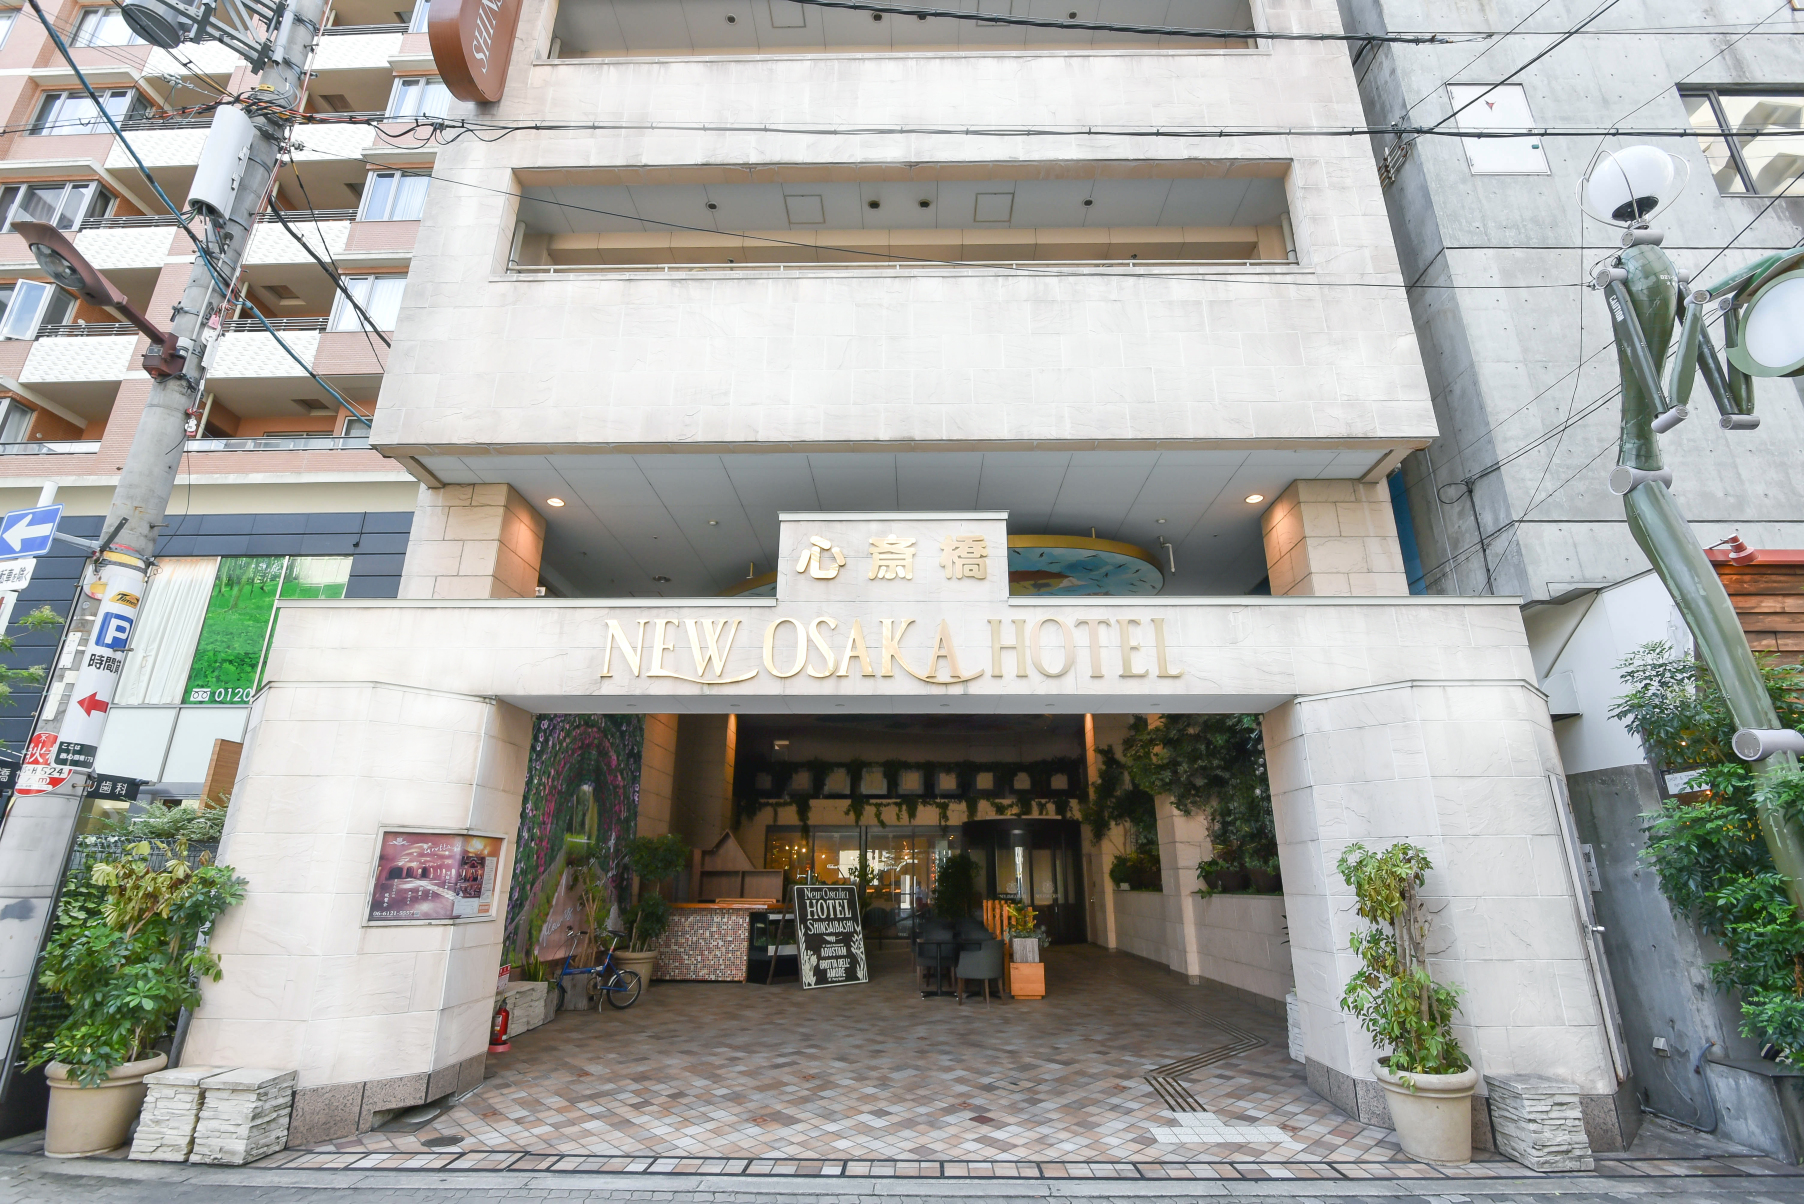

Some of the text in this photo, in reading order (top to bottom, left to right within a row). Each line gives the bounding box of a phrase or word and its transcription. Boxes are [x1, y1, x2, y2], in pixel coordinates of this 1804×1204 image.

[472, 0, 503, 74] SHIN
[1609, 295, 1625, 322] CAUTION
[796, 534, 989, 580] 心斎橋
[104, 618, 130, 645] P
[600, 616, 1184, 684] NEW OSAKA HOTEL
[215, 688, 253, 701] 0120
[40, 766, 63, 777] 524
[804, 888, 849, 899] New Osaka
[806, 900, 852, 919] HOTEL
[807, 920, 854, 934] SHINSAIBASHI
[819, 959, 837, 970] GROTTA
[827, 968, 846, 978] AMORE
